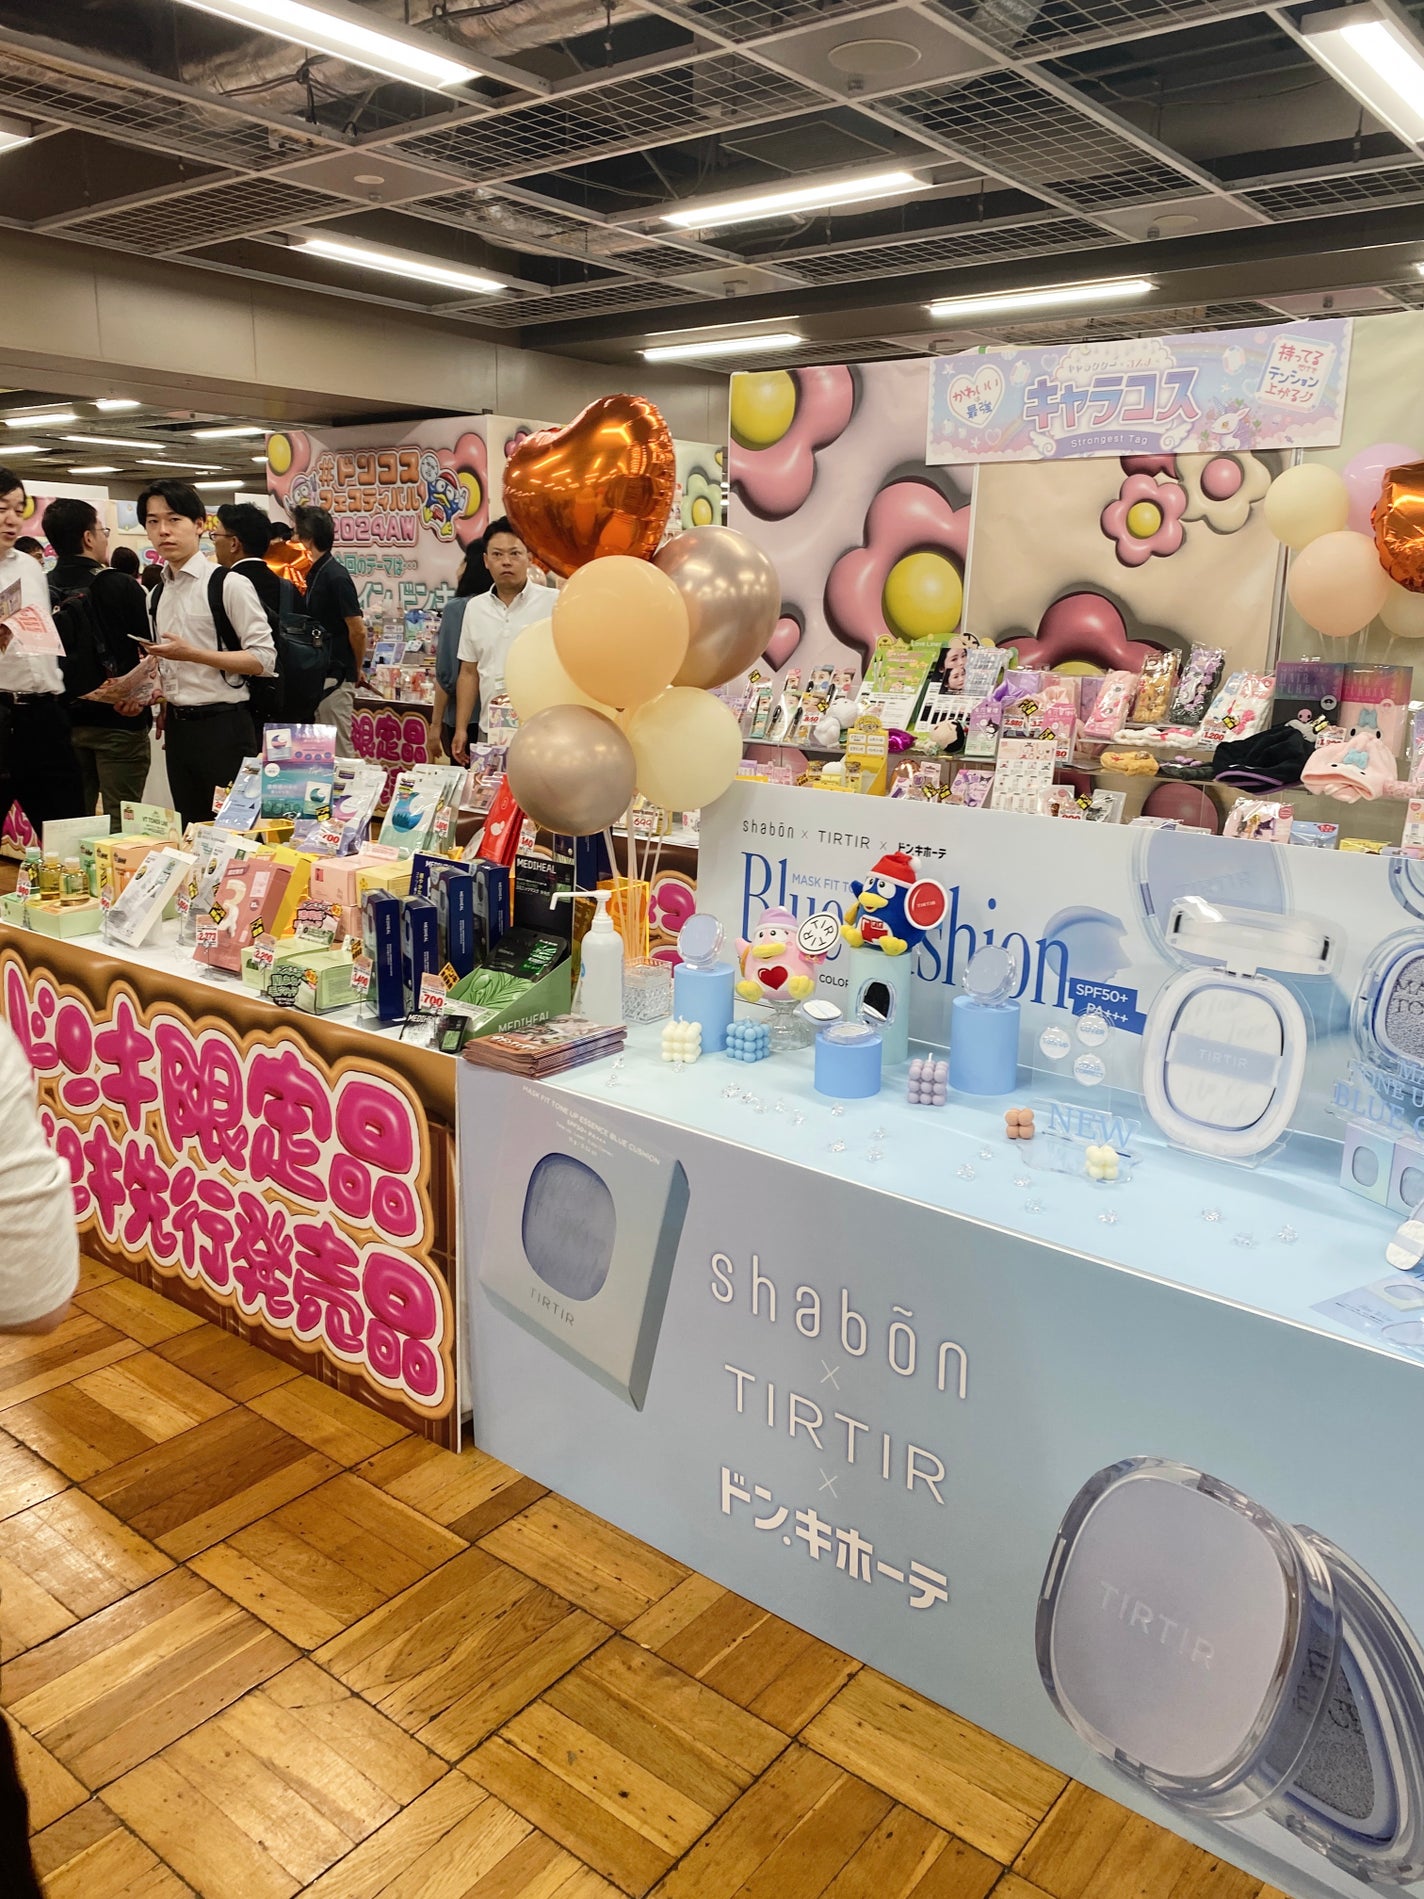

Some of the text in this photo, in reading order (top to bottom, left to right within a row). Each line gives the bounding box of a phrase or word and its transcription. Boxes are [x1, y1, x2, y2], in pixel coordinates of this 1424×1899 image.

[952, 379, 999, 403] かわいい
[1268, 366, 1320, 388] テンション
[1026, 369, 1200, 429] キャラコス
[1071, 434, 1148, 448] Strongest Tag
[319, 452, 420, 487] #ドンコス
[320, 486, 420, 513] フェスティバル
[818, 830, 870, 849] TIRTIR
[516, 858, 557, 874] MEDIHEAL
[792, 873, 821, 888] MASK
[824, 878, 841, 891] FIT
[423, 993, 444, 1008] 700
[1075, 983, 1128, 1003] SPF50+
[1334, 1082, 1405, 1132] BLUE
[523, 1085, 540, 1098] MASK
[541, 1094, 550, 1104] FIT
[552, 1100, 568, 1115] TONE
[569, 1109, 579, 1119] UP
[579, 1115, 608, 1137] ESSENCE
[609, 1131, 628, 1147] BLUE
[628, 1143, 660, 1165] CUSHION
[1048, 1102, 1136, 1149] NEW
[41, 1112, 438, 1396] ンキ先行発売品
[530, 1287, 575, 1327] TIRTIR
[724, 1364, 946, 1504] TIRTIR
[1099, 1581, 1217, 1672] TIRTIR
